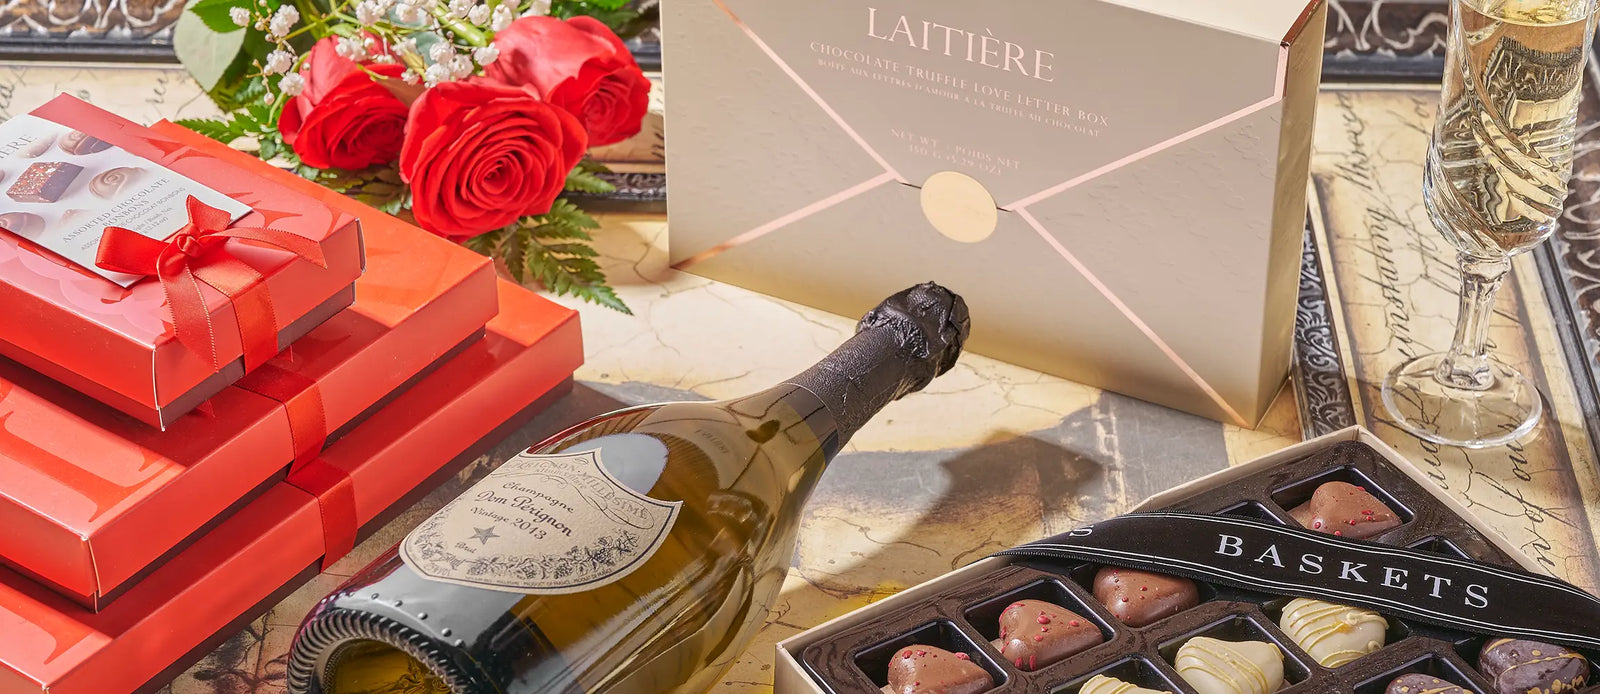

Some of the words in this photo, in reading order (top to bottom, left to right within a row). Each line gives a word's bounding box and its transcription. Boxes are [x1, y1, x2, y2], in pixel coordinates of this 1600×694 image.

[866, 7, 1055, 83] LAITIÈRE
[809, 41, 901, 73] CHOCOLATE
[905, 64, 968, 89] TRUFFLE
[974, 82, 1012, 101] LOVE
[1017, 94, 1070, 117] LETTER
[1077, 109, 1110, 127] BOX
[850, 66, 869, 78] AUX
[872, 72, 912, 89] LETTRES
[974, 98, 985, 108] LA
[990, 102, 1025, 118] TRUFFE
[1028, 112, 1042, 122] AU
[1044, 116, 1099, 138] CHOCOLAT
[890, 128, 915, 142] NET
[954, 144, 993, 162] POIDS
[996, 156, 1021, 169] NET
[61, 210, 111, 244] ASSORTED
[109, 177, 171, 213] CHOCOLATE
[102, 197, 151, 227] BONBONS
[475, 490, 508, 510] Dom
[511, 494, 574, 538] Pérignon
[502, 480, 575, 514] Champagne
[470, 506, 510, 525] Vintage
[511, 517, 548, 540] 2013
[454, 541, 477, 555] Brut
[1214, 533, 1489, 609] BASKETS
